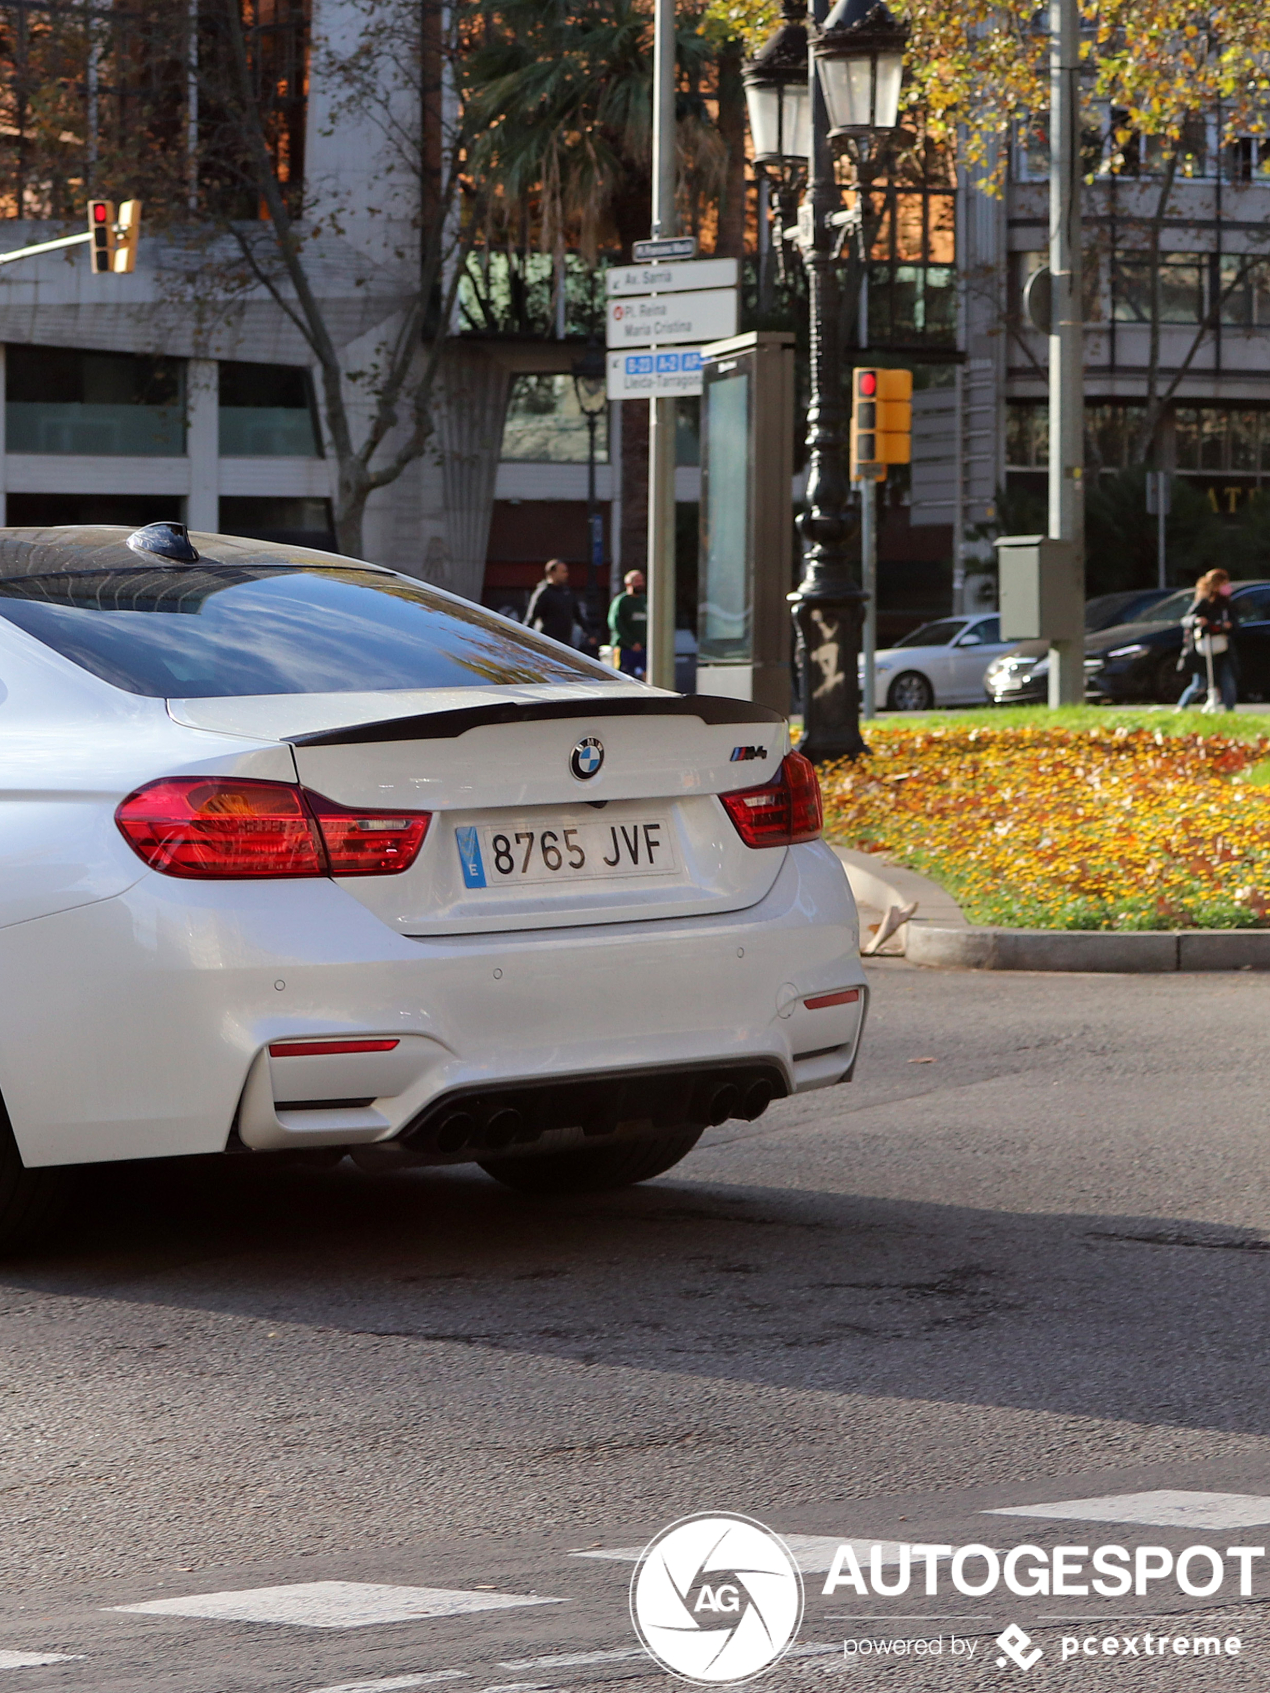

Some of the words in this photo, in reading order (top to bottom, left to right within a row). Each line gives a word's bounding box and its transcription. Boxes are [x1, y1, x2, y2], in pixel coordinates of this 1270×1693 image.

[654, 321, 692, 334] Cristina
[469, 863, 479, 877] E
[493, 829, 586, 875] 8765
[602, 823, 661, 867] JVF
